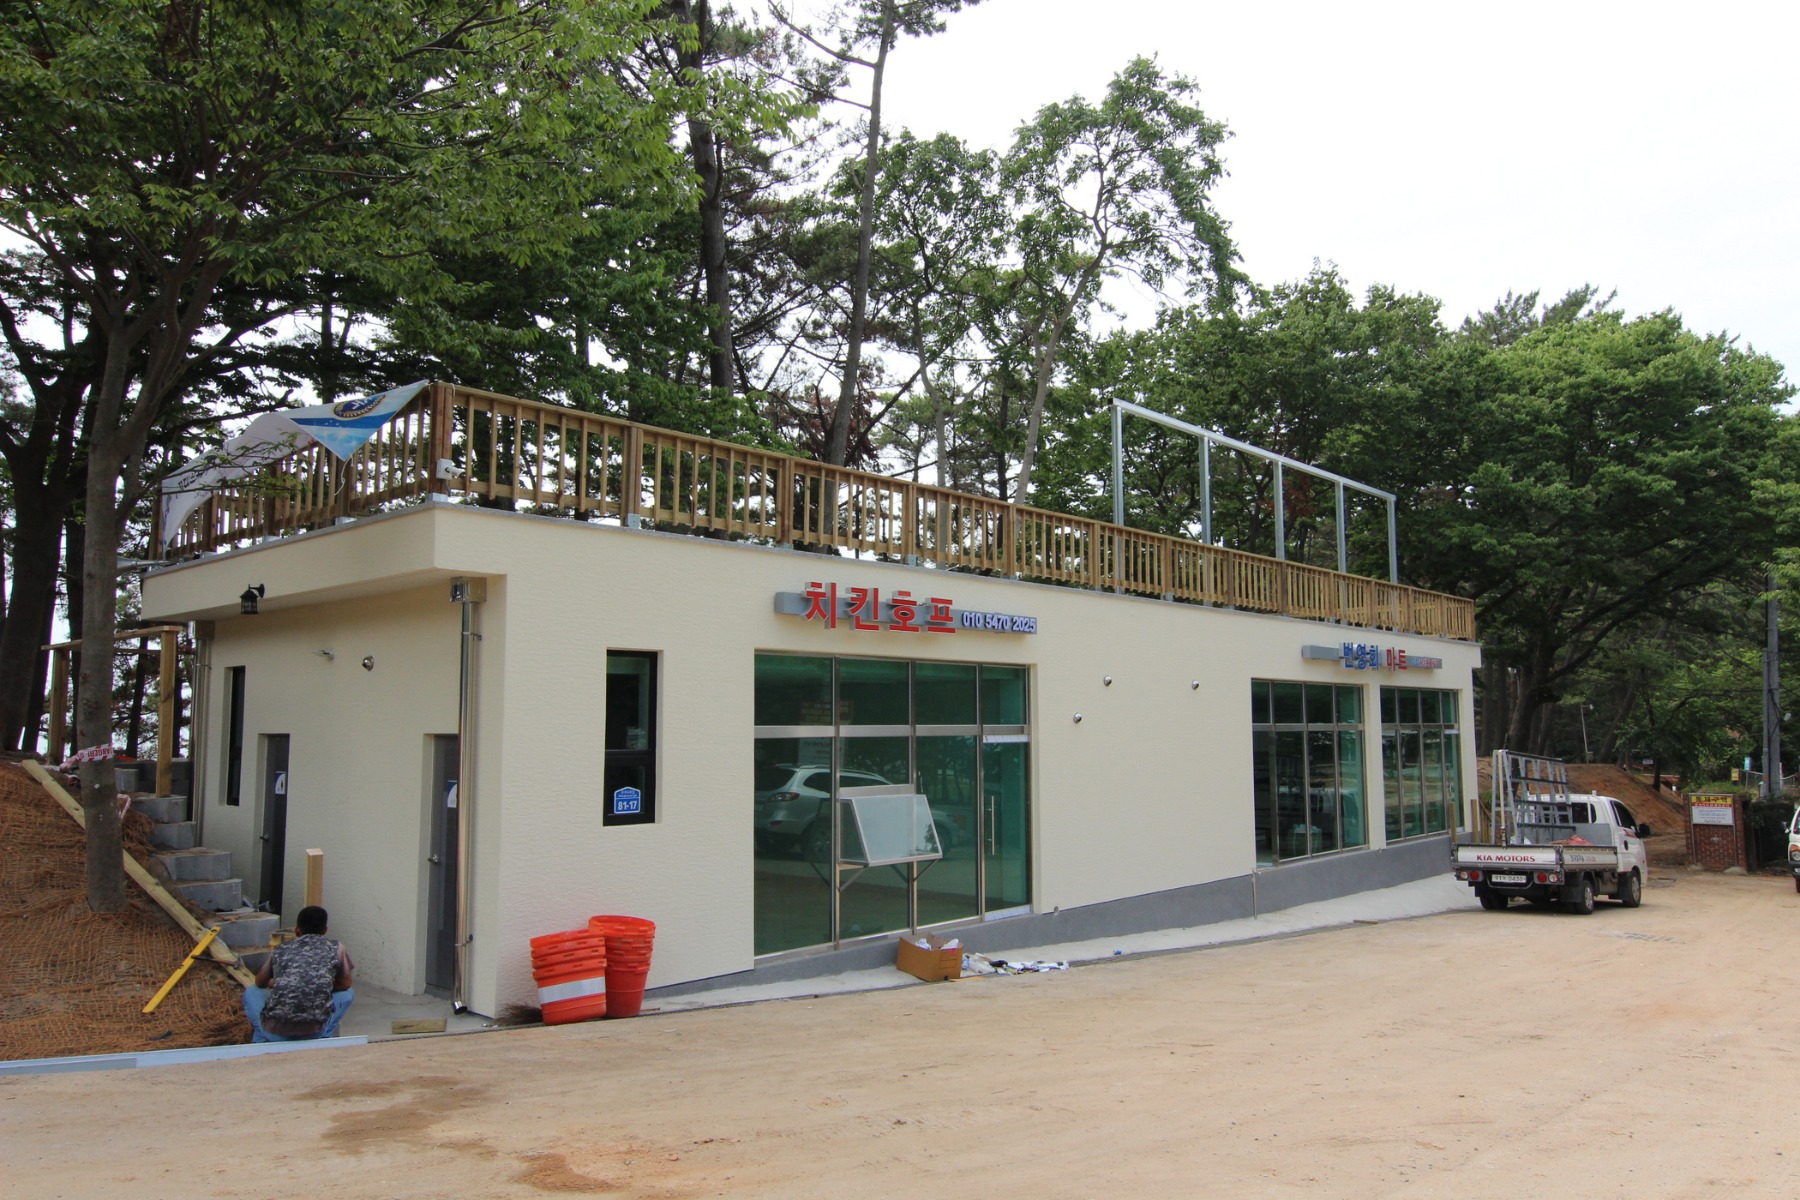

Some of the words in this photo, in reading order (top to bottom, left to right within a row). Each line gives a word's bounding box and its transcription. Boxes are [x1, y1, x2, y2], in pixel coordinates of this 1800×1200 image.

[804, 581, 956, 634] 치킨호프
[962, 611, 983, 628] 010
[984, 613, 1010, 630] 5470
[1012, 616, 1036, 633] 2025
[1343, 642, 1379, 671] 번영회
[1386, 647, 1408, 672] 마트
[618, 801, 638, 811] 81-17
[1495, 855, 1536, 863] MOTORS
